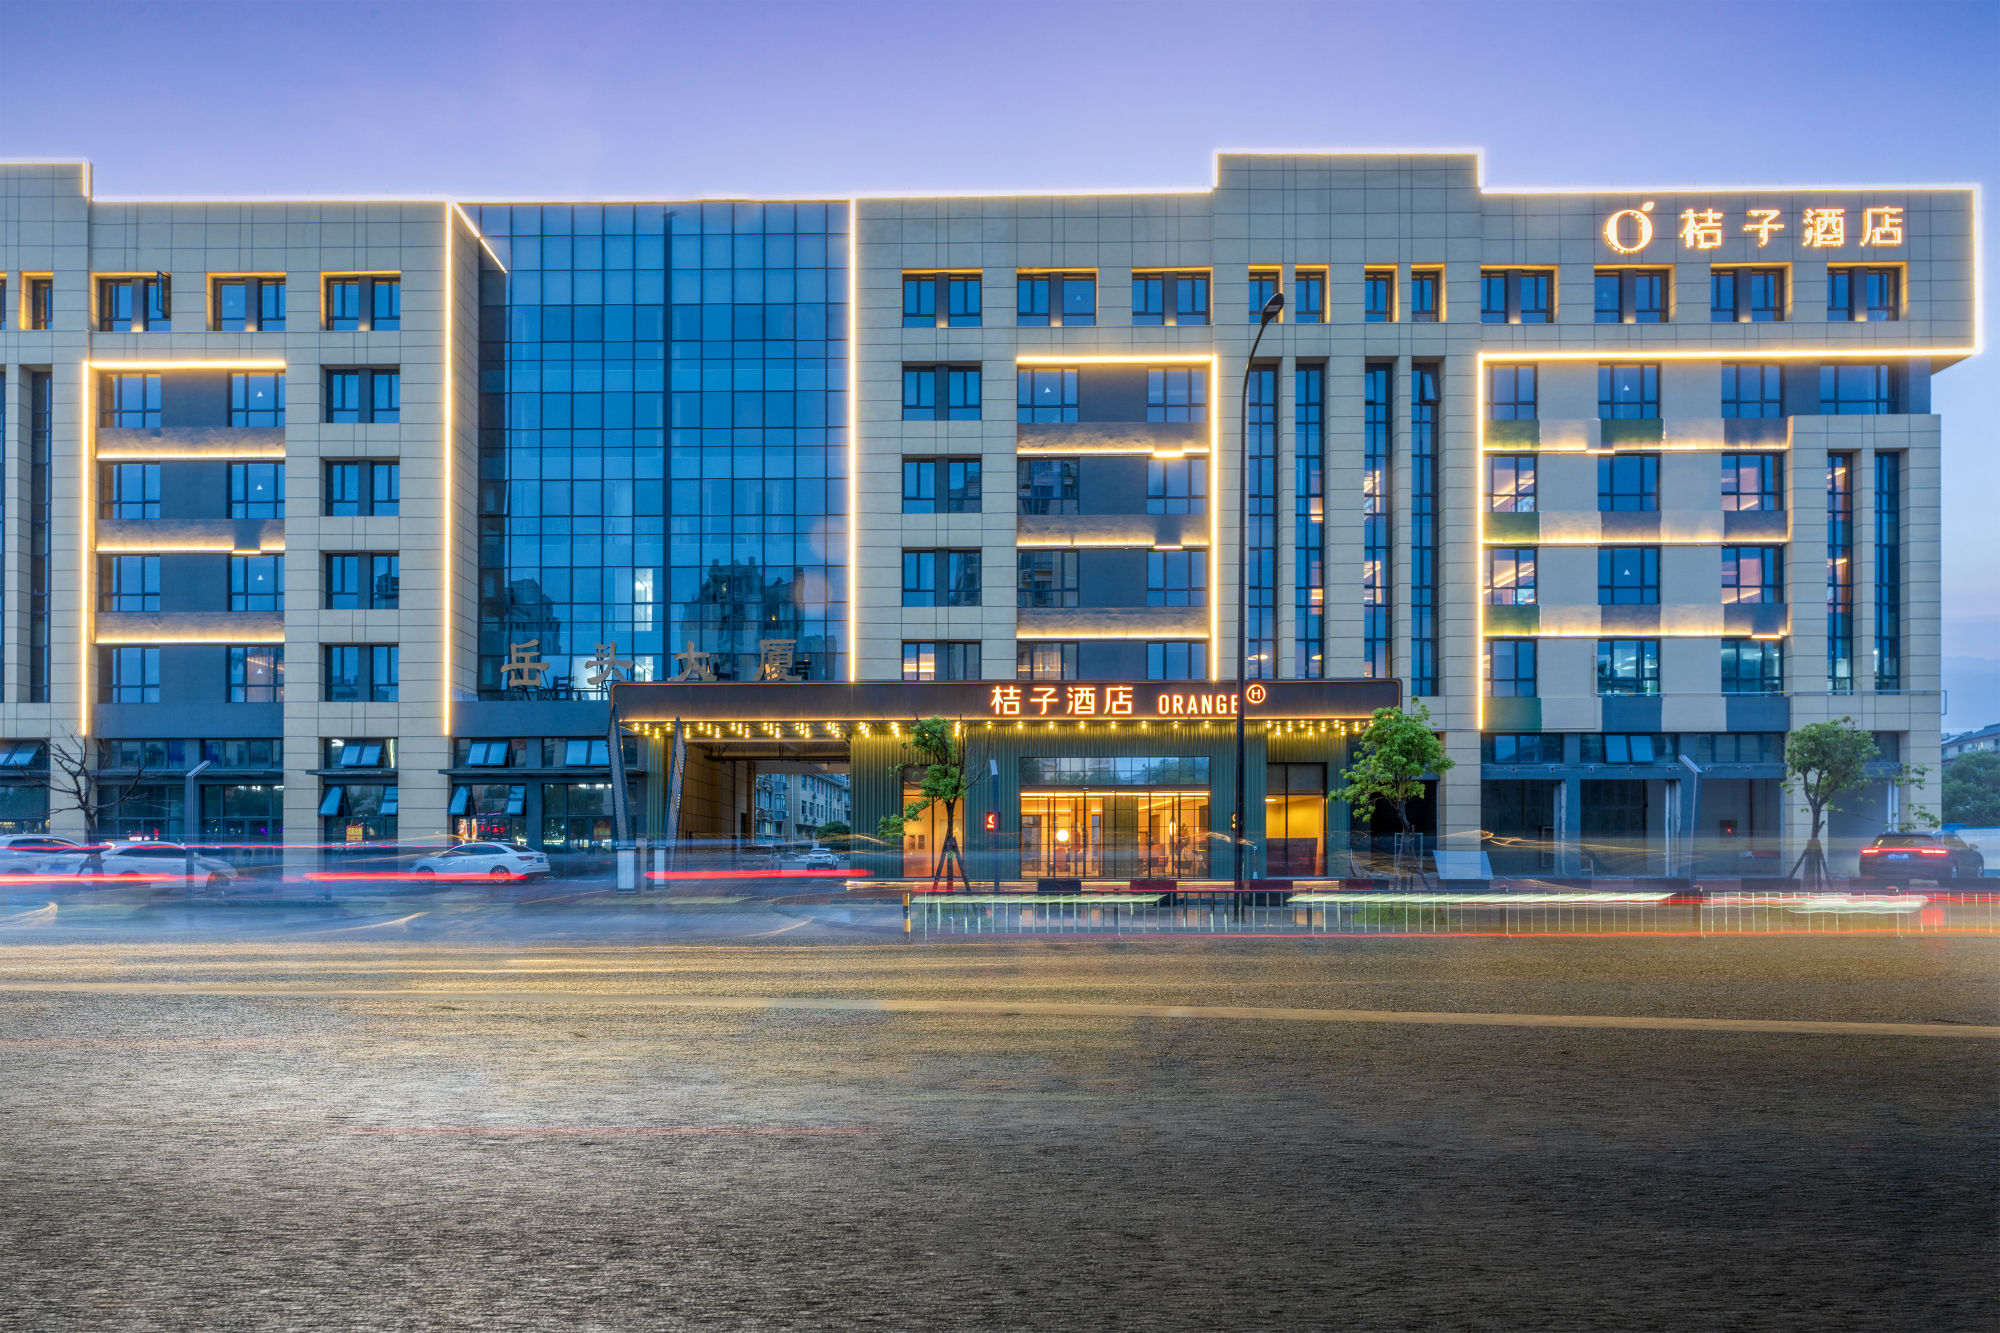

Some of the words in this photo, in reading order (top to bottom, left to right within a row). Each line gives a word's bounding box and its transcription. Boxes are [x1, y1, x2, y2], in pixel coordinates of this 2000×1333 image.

[1680, 206, 1904, 249] 桔子酒店
[500, 639, 803, 687] 岳头大厦
[991, 685, 1134, 715] 桔子酒店
[1158, 694, 1238, 715] ORANGE
